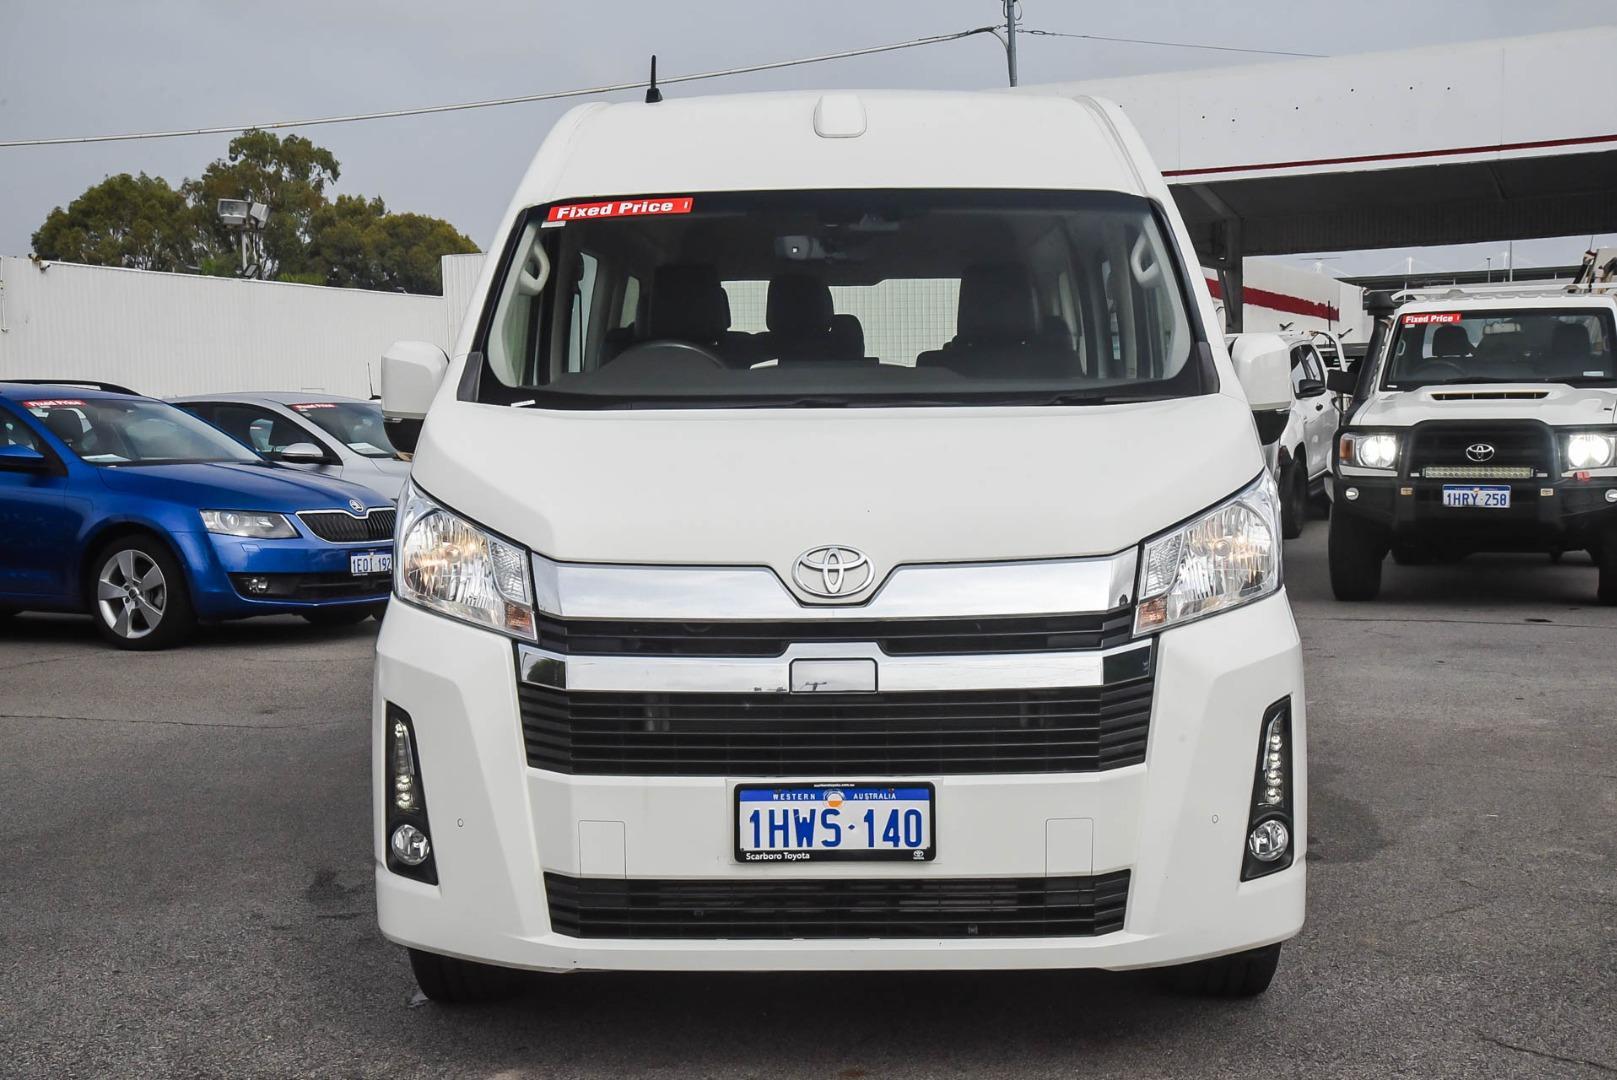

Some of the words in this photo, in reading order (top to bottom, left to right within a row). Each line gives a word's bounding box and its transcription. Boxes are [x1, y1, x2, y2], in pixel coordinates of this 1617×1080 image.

[556, 203, 614, 219] Fixed
[618, 201, 674, 214] Price
[1405, 315, 1429, 323] Fixed
[1430, 314, 1454, 322] Price
[772, 793, 816, 801] WESTERN
[853, 792, 897, 801] AUSTRALIA
[745, 852, 782, 860] Scarboro
[783, 851, 810, 861] Toyota
